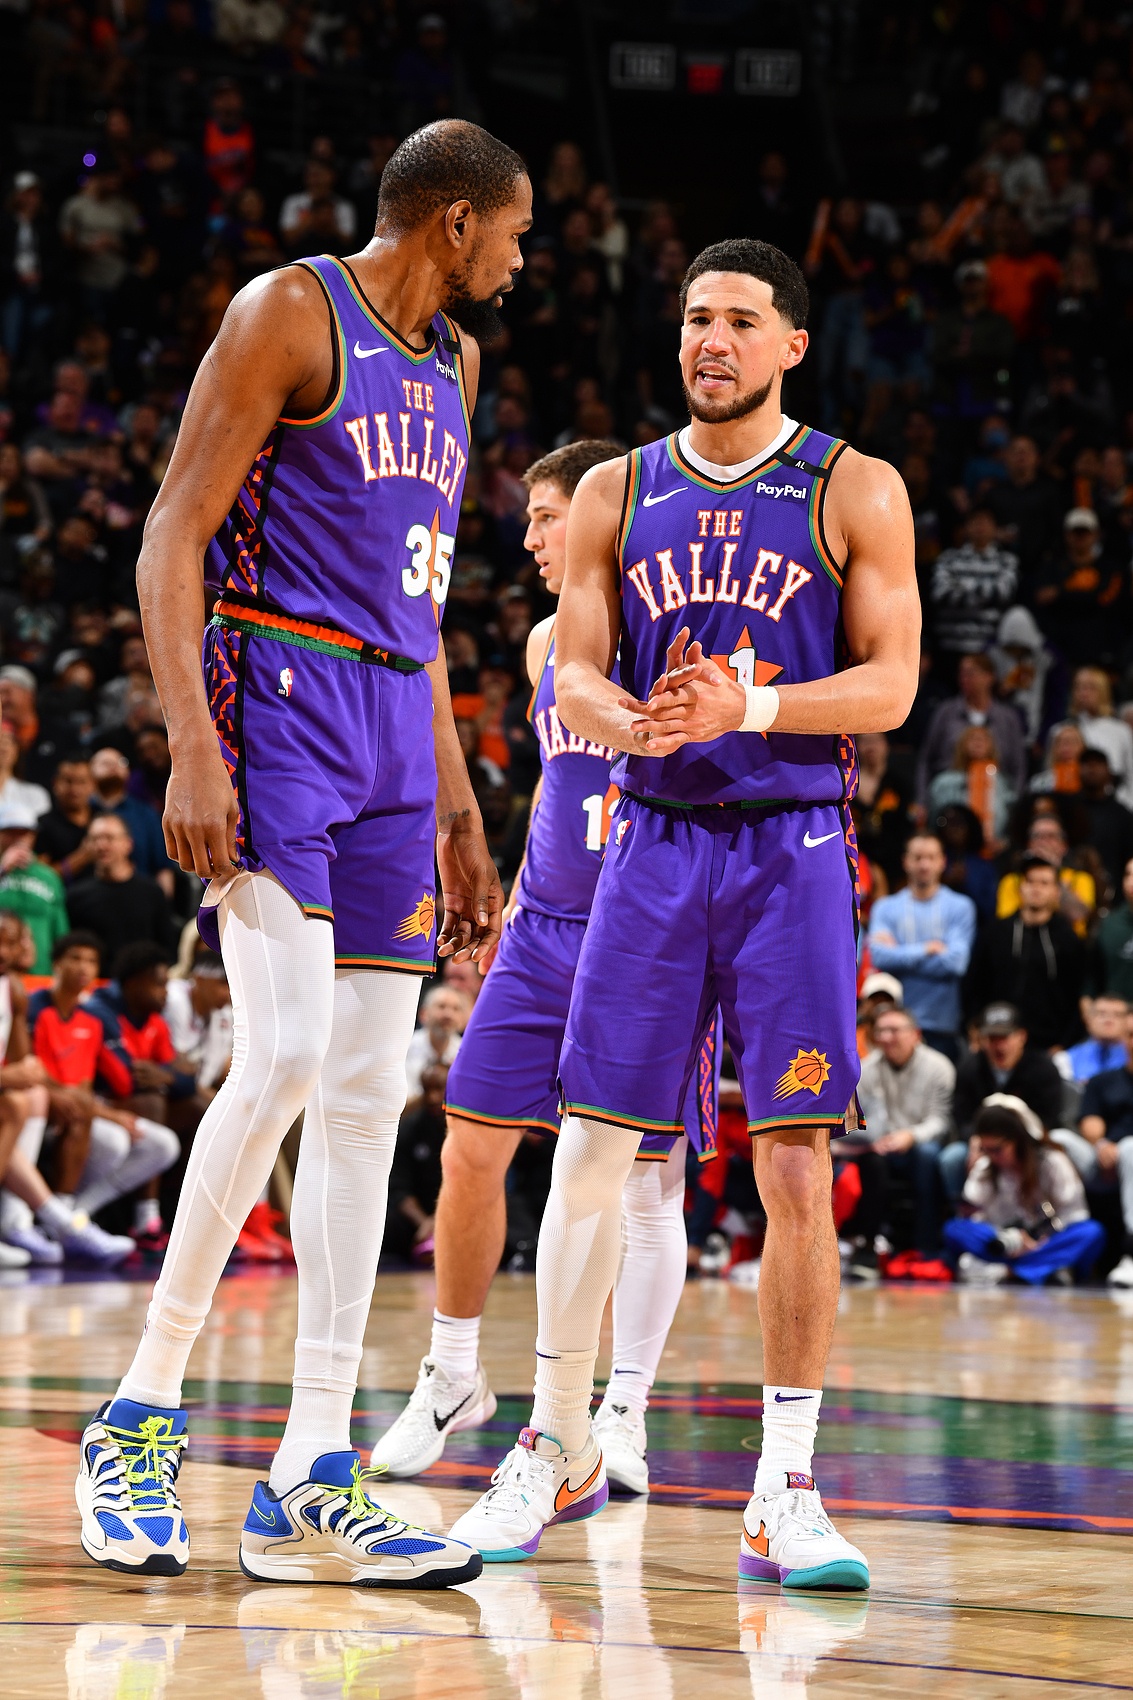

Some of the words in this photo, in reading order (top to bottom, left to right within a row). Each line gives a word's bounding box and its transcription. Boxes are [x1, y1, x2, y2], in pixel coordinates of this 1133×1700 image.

[401, 378, 435, 414] THE
[344, 412, 467, 508] VALLEY
[795, 461, 806, 470] AL
[756, 481, 807, 499] PayPal
[697, 510, 743, 537] THE
[401, 522, 456, 606] 35
[626, 542, 814, 623] VALLEY
